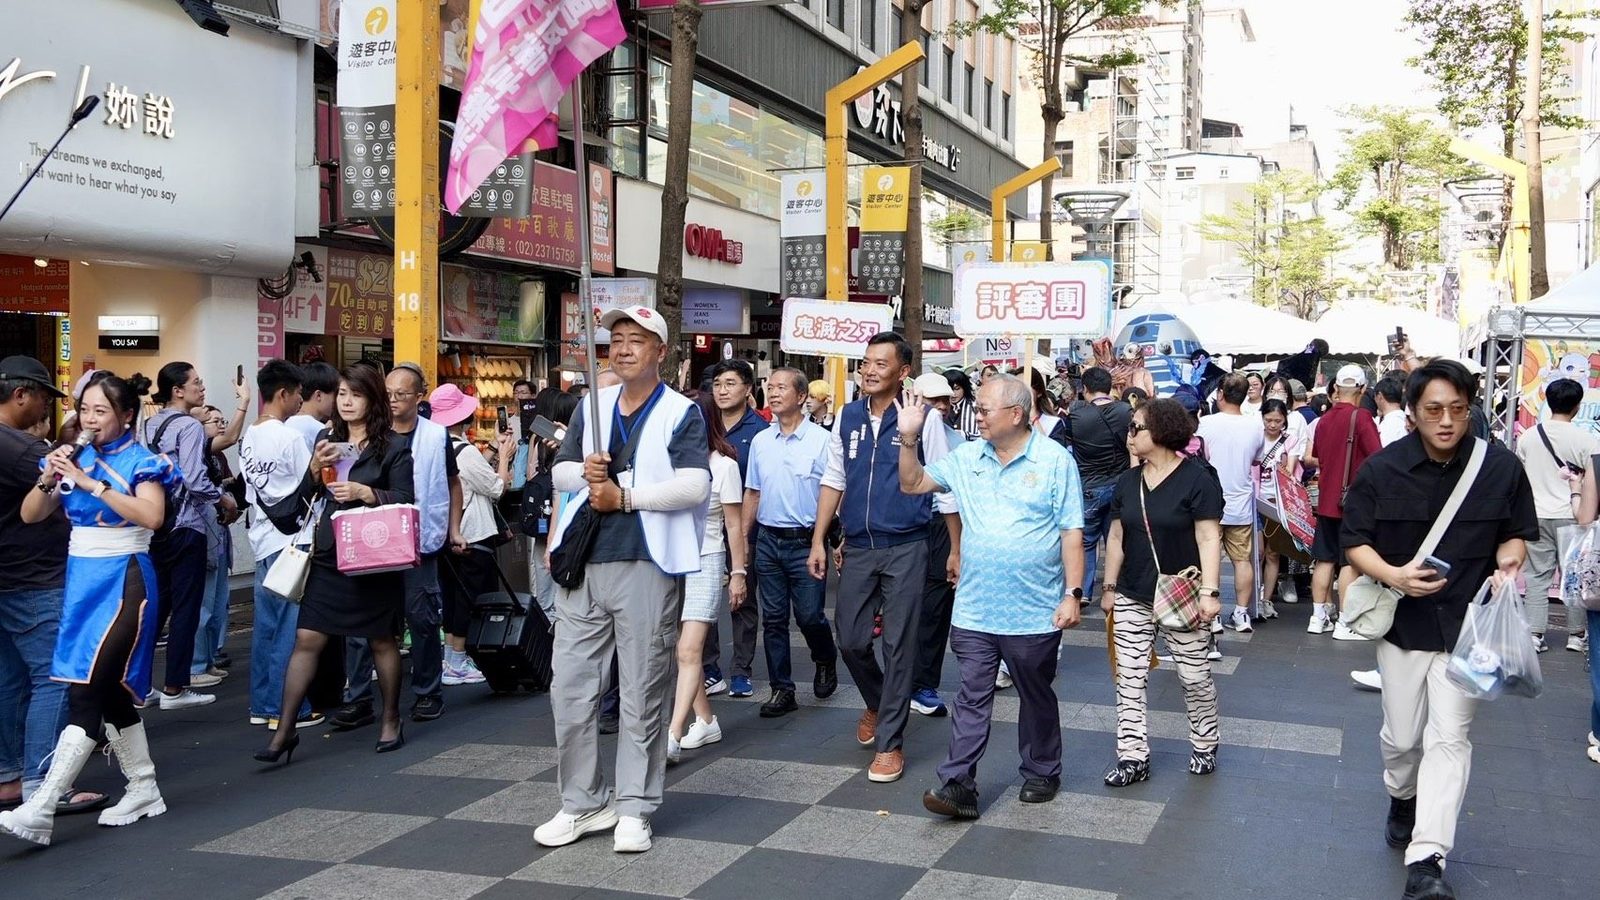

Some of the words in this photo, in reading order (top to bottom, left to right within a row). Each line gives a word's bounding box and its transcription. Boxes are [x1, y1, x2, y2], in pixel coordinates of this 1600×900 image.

[347, 59, 374, 68] Visitor
[378, 58, 396, 66] Cent
[104, 82, 175, 138] 妳說
[29, 142, 48, 158] The
[52, 147, 90, 166] dreams
[92, 157, 107, 169] we
[111, 160, 165, 182] exchanged,
[48, 169, 73, 184] want
[76, 174, 86, 186] to
[89, 174, 112, 191] hear
[115, 180, 138, 195] what
[140, 186, 158, 199] you
[161, 191, 177, 204] say
[685, 223, 728, 263] OMA
[400, 251, 416, 271] H
[329, 282, 352, 308] 70
[397, 292, 419, 312] 18
[976, 280, 1085, 320] 評審團
[340, 312, 385, 333] 吃到飽
[792, 314, 881, 343] 鬼滅之刃
[111, 339, 126, 347] YOU
[127, 339, 139, 347] SAY
